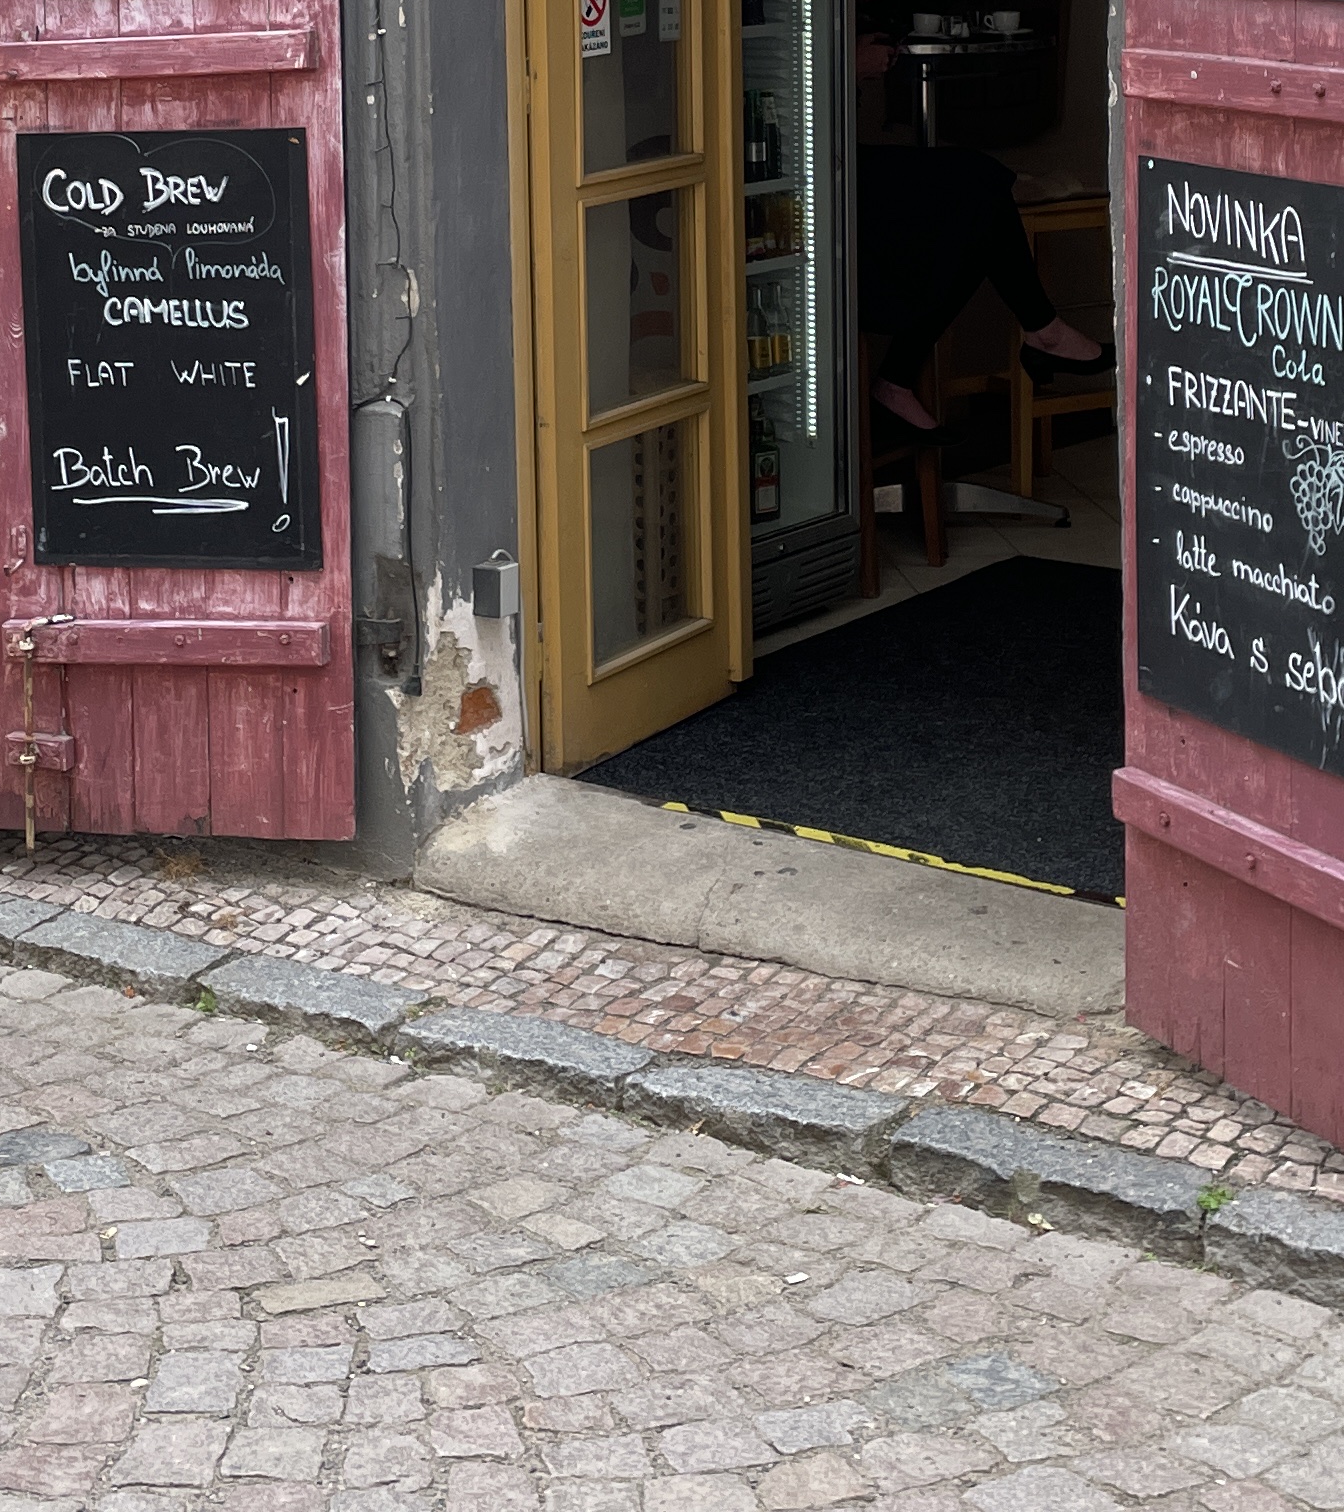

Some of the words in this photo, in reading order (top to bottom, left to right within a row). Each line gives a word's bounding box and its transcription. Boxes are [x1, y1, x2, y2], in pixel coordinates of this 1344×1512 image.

[42, 168, 124, 215] COLD
[140, 167, 229, 213] BREW
[1167, 181, 1306, 265] NOVINKA
[68, 249, 163, 296] bylinná
[186, 247, 285, 285] limonáda
[104, 297, 250, 329] CAMELLUS
[1152, 267, 1232, 331] ROYAL
[1223, 273, 1343, 351] CROWN
[67, 359, 134, 387] FLAT
[171, 359, 256, 388] WHITE
[1272, 344, 1326, 386] Cola
[51, 445, 153, 490] Batch
[1168, 429, 1245, 465] espresso
[1172, 482, 1273, 533] cappuccino
[1176, 530, 1221, 576] latte
[1232, 558, 1336, 615] macchiato
[1170, 584, 1235, 659] Káva
